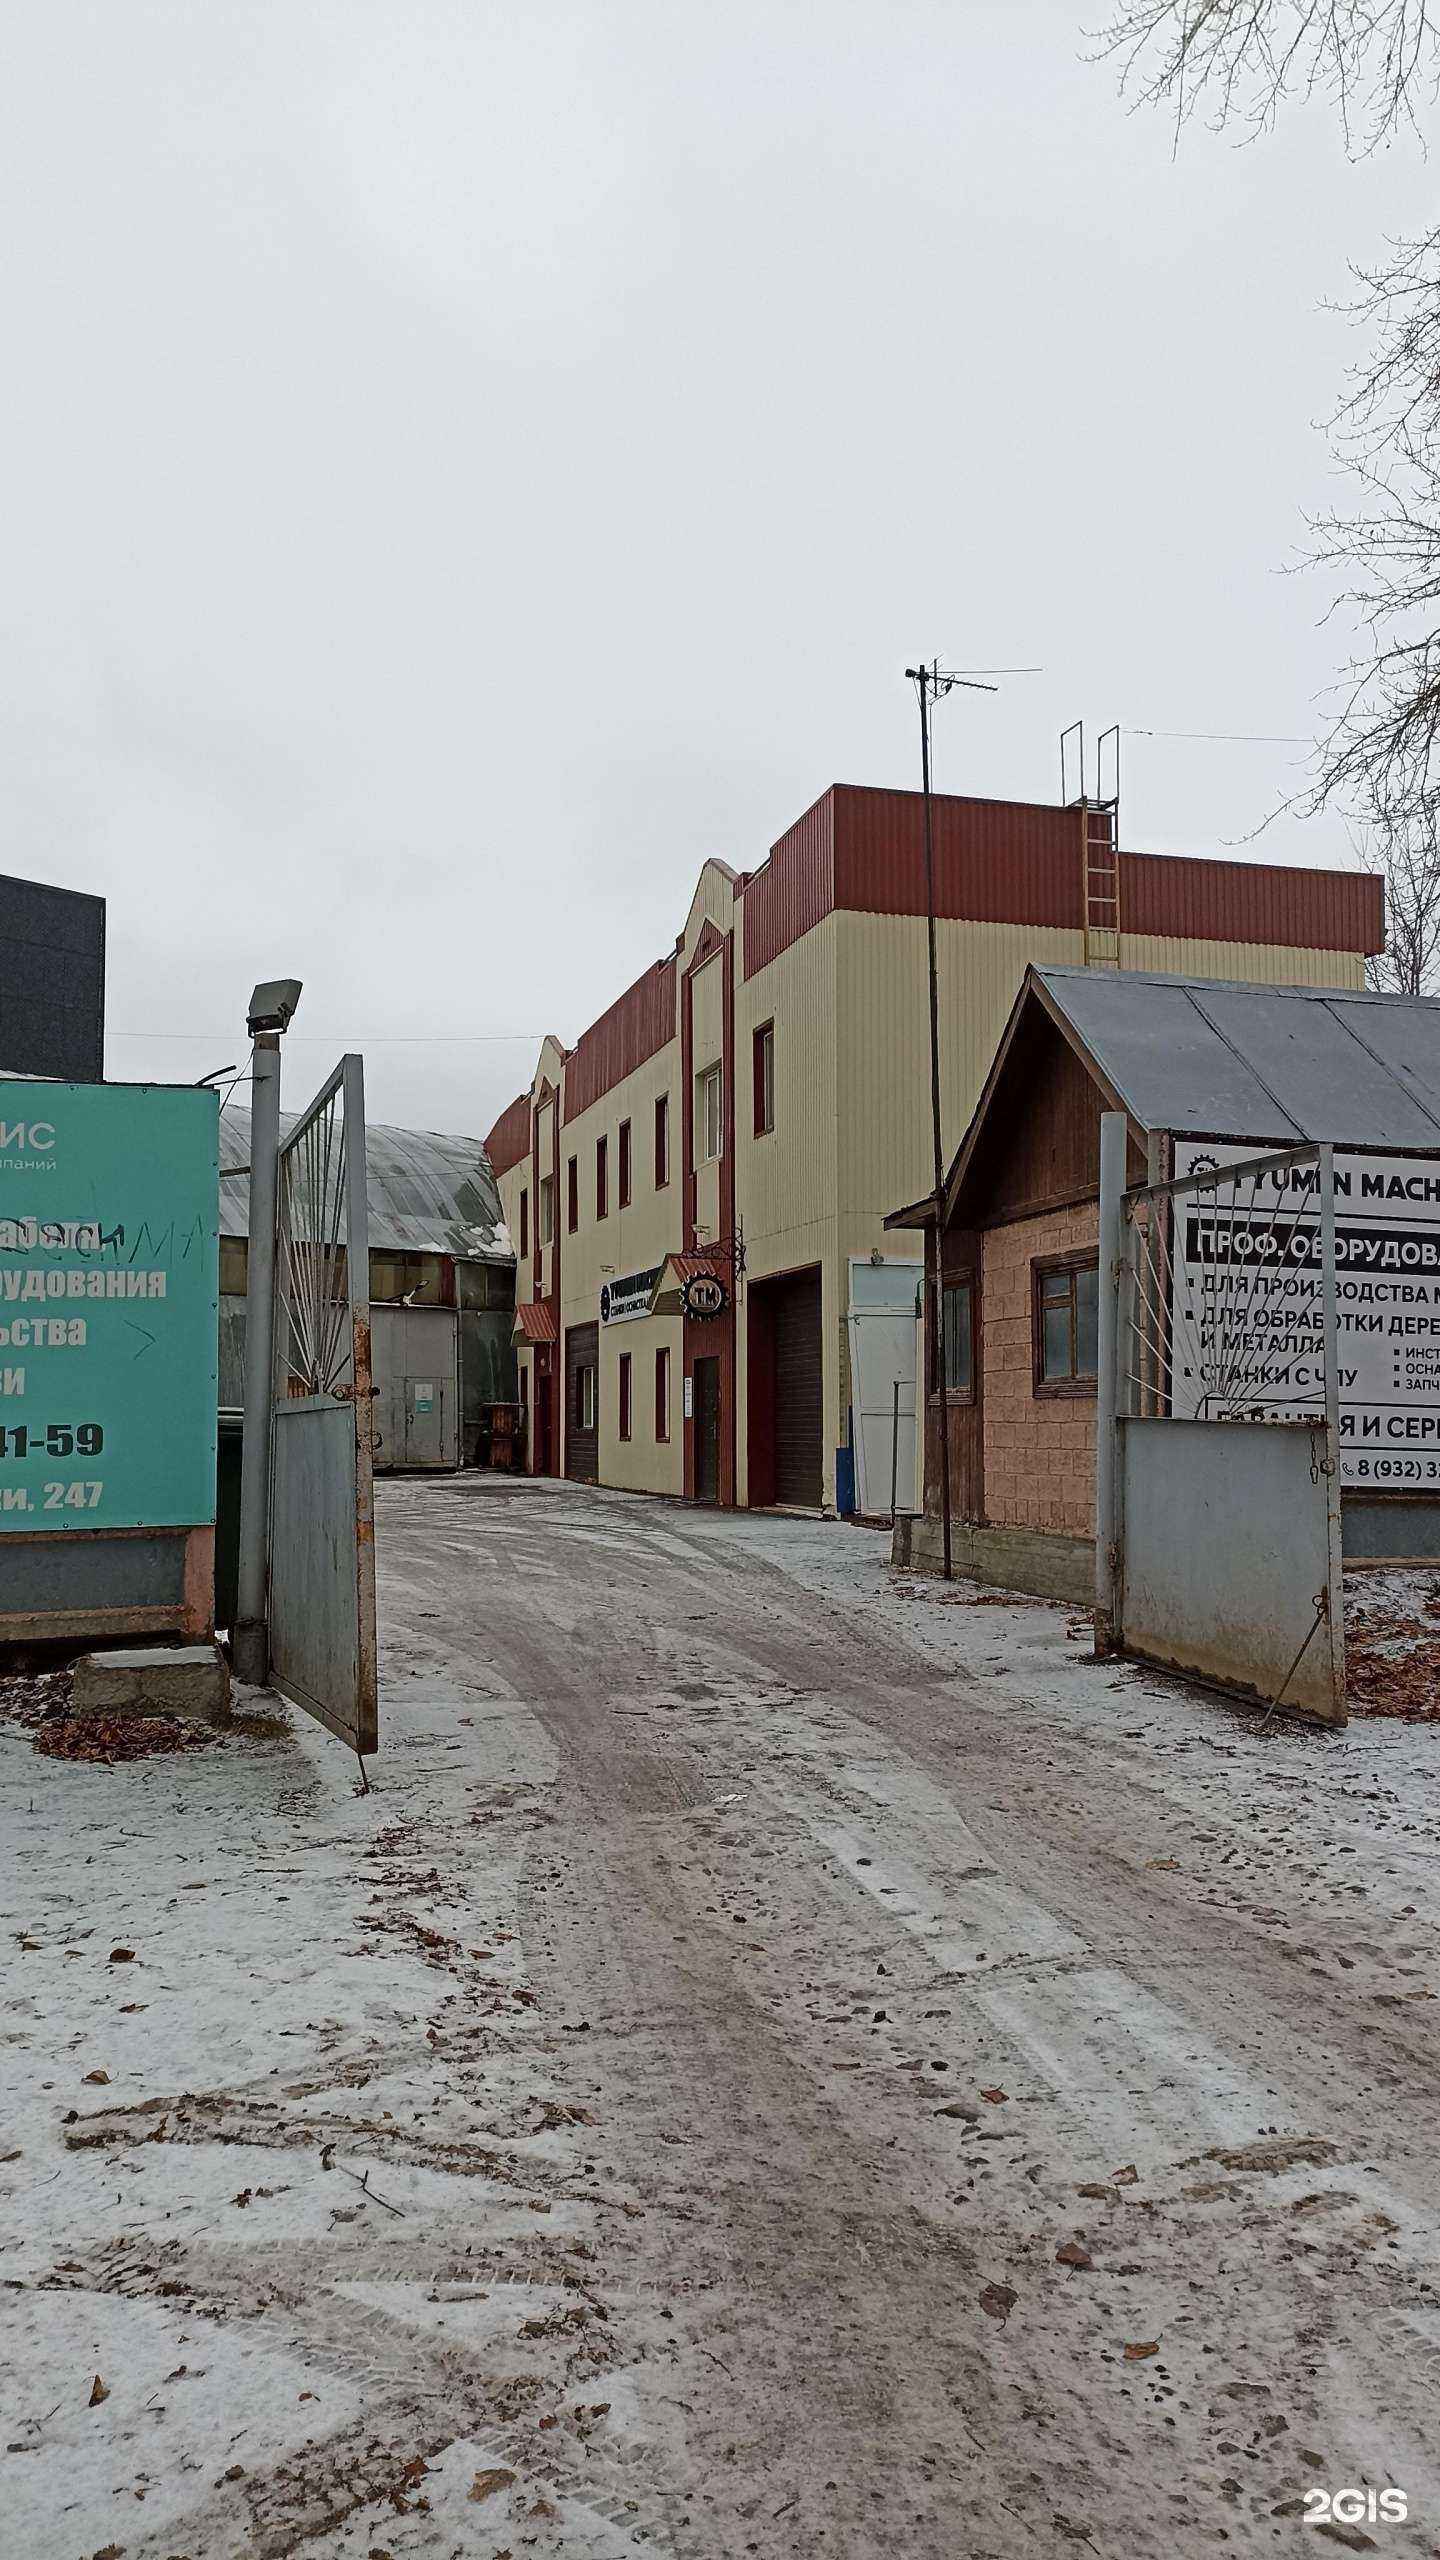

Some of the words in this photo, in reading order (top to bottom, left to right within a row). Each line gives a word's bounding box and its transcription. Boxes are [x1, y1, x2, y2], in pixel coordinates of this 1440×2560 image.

[0, 1157, 57, 1171] паний
[1234, 1166, 1352, 1196] YUMN
[1197, 1229, 1284, 1257] ПРОФ.
[1291, 1235, 1440, 1268] ОБОРУДОВ
[0, 1270, 167, 1302] удования
[1201, 1274, 1248, 1295] ДЛЯ
[1201, 1307, 1249, 1328] ДЛЯ
[1253, 1309, 1383, 1333] ОБРАБТКИ
[1200, 1331, 1216, 1351] И
[1222, 1332, 1325, 1354] МЕТАЛЛА
[1295, 1367, 1310, 1386] С
[1363, 1415, 1381, 1438] И
[1387, 1416, 1440, 1440] СЕР
[1358, 1459, 1370, 1477] 8
[1374, 1460, 1422, 1481] (932)
[1427, 1461, 1440, 1478] 3
[43, 1481, 103, 1510] 247
